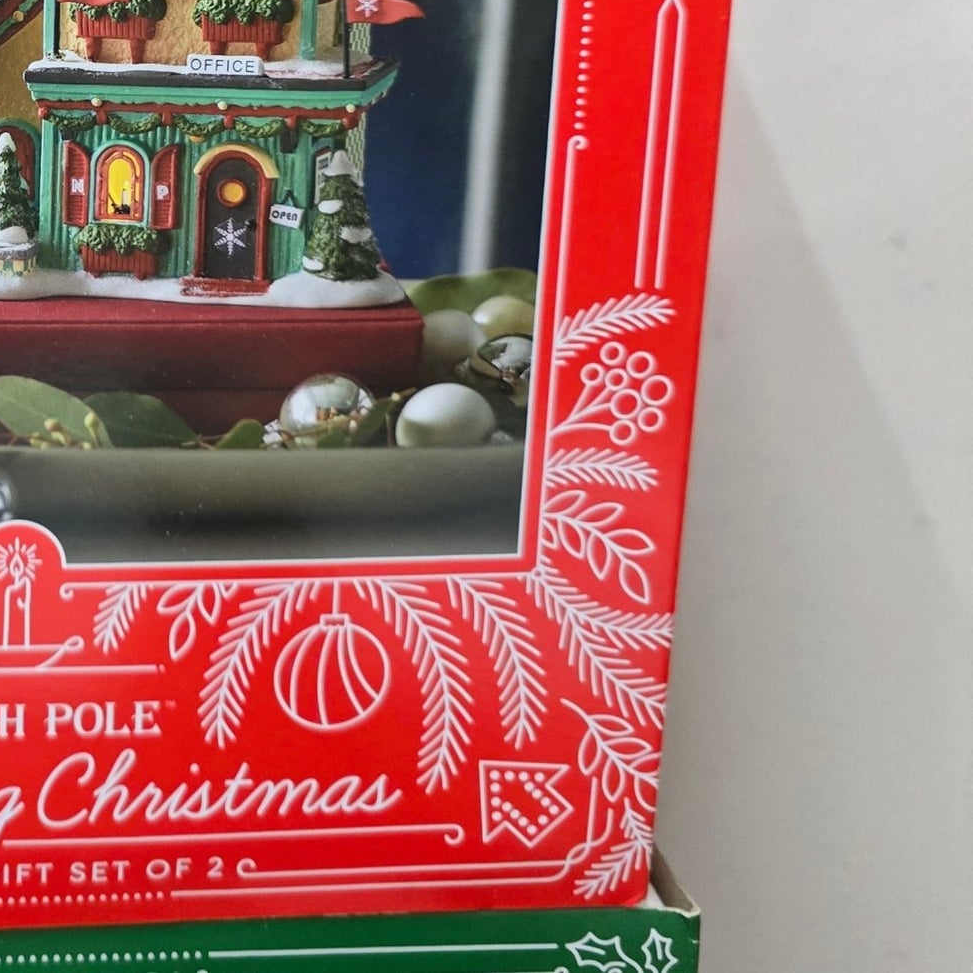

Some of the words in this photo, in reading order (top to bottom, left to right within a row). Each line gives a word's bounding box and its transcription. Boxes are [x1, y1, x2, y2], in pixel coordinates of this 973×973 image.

[190, 58, 256, 74] OFFICE
[71, 179, 85, 194] N
[156, 185, 169, 199] P
[271, 209, 298, 223] OPEN
[37, 748, 402, 826] Christmas
[70, 860, 130, 883] SET
[146, 857, 192, 880] OF
[207, 857, 223, 879] 2
